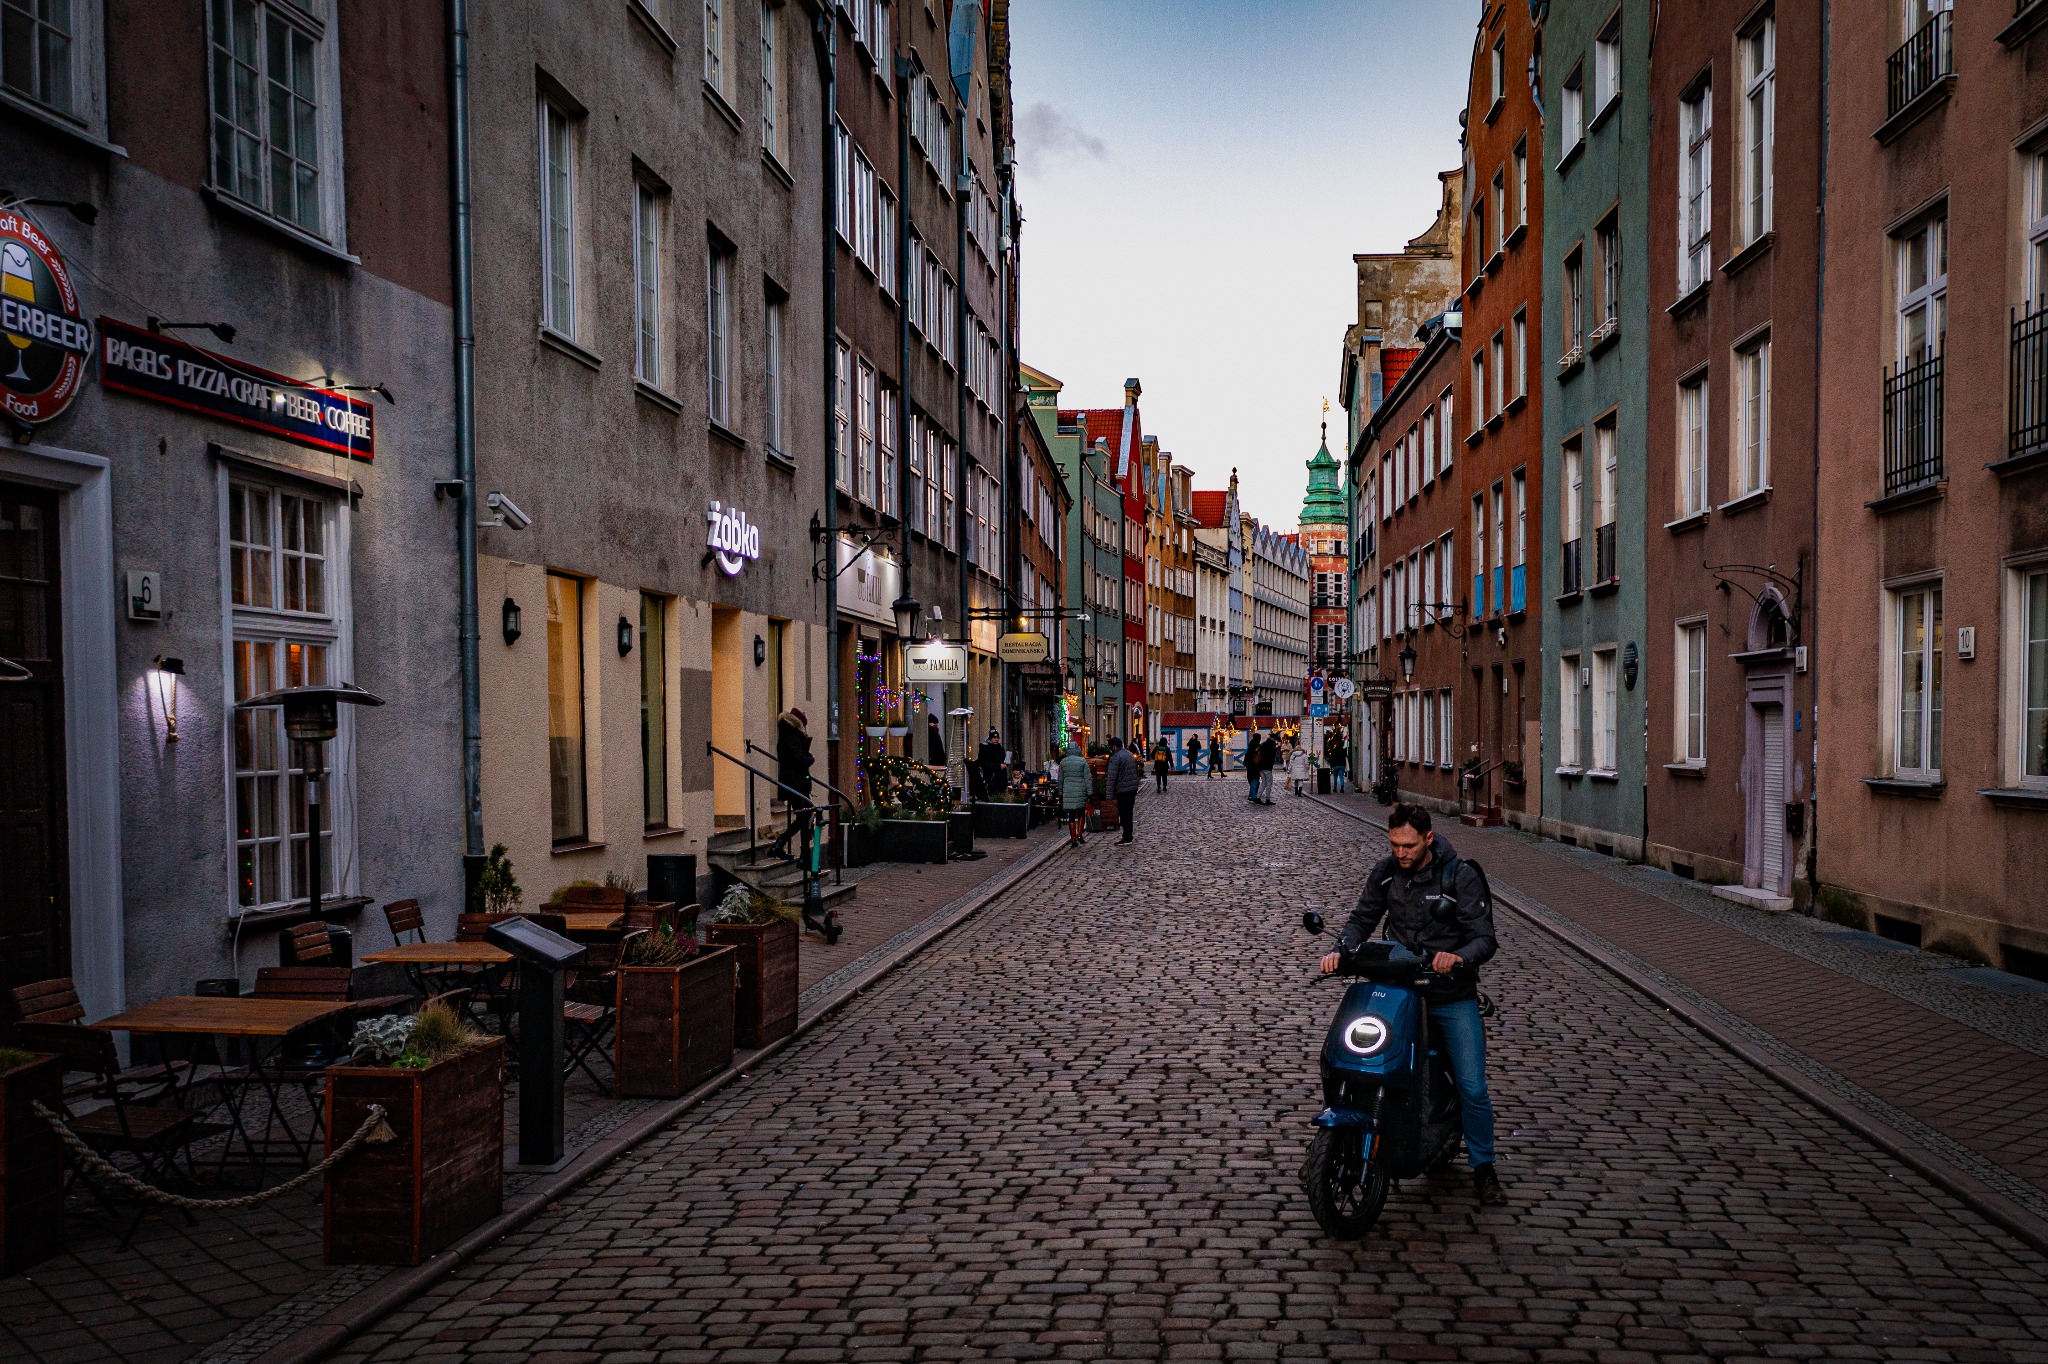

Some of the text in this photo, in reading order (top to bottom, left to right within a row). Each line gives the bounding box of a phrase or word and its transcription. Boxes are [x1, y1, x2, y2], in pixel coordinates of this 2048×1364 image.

[0, 216, 52, 254] aft Beer
[0, 299, 89, 353] ERBEER
[6, 392, 39, 417] Food
[106, 337, 370, 440] BAGELS PIZZA CRAFT BEER COFFEE
[707, 500, 759, 559] żabka
[142, 576, 152, 604] 6
[1961, 630, 1970, 649] 10
[930, 659, 959, 671] FAMILIA
